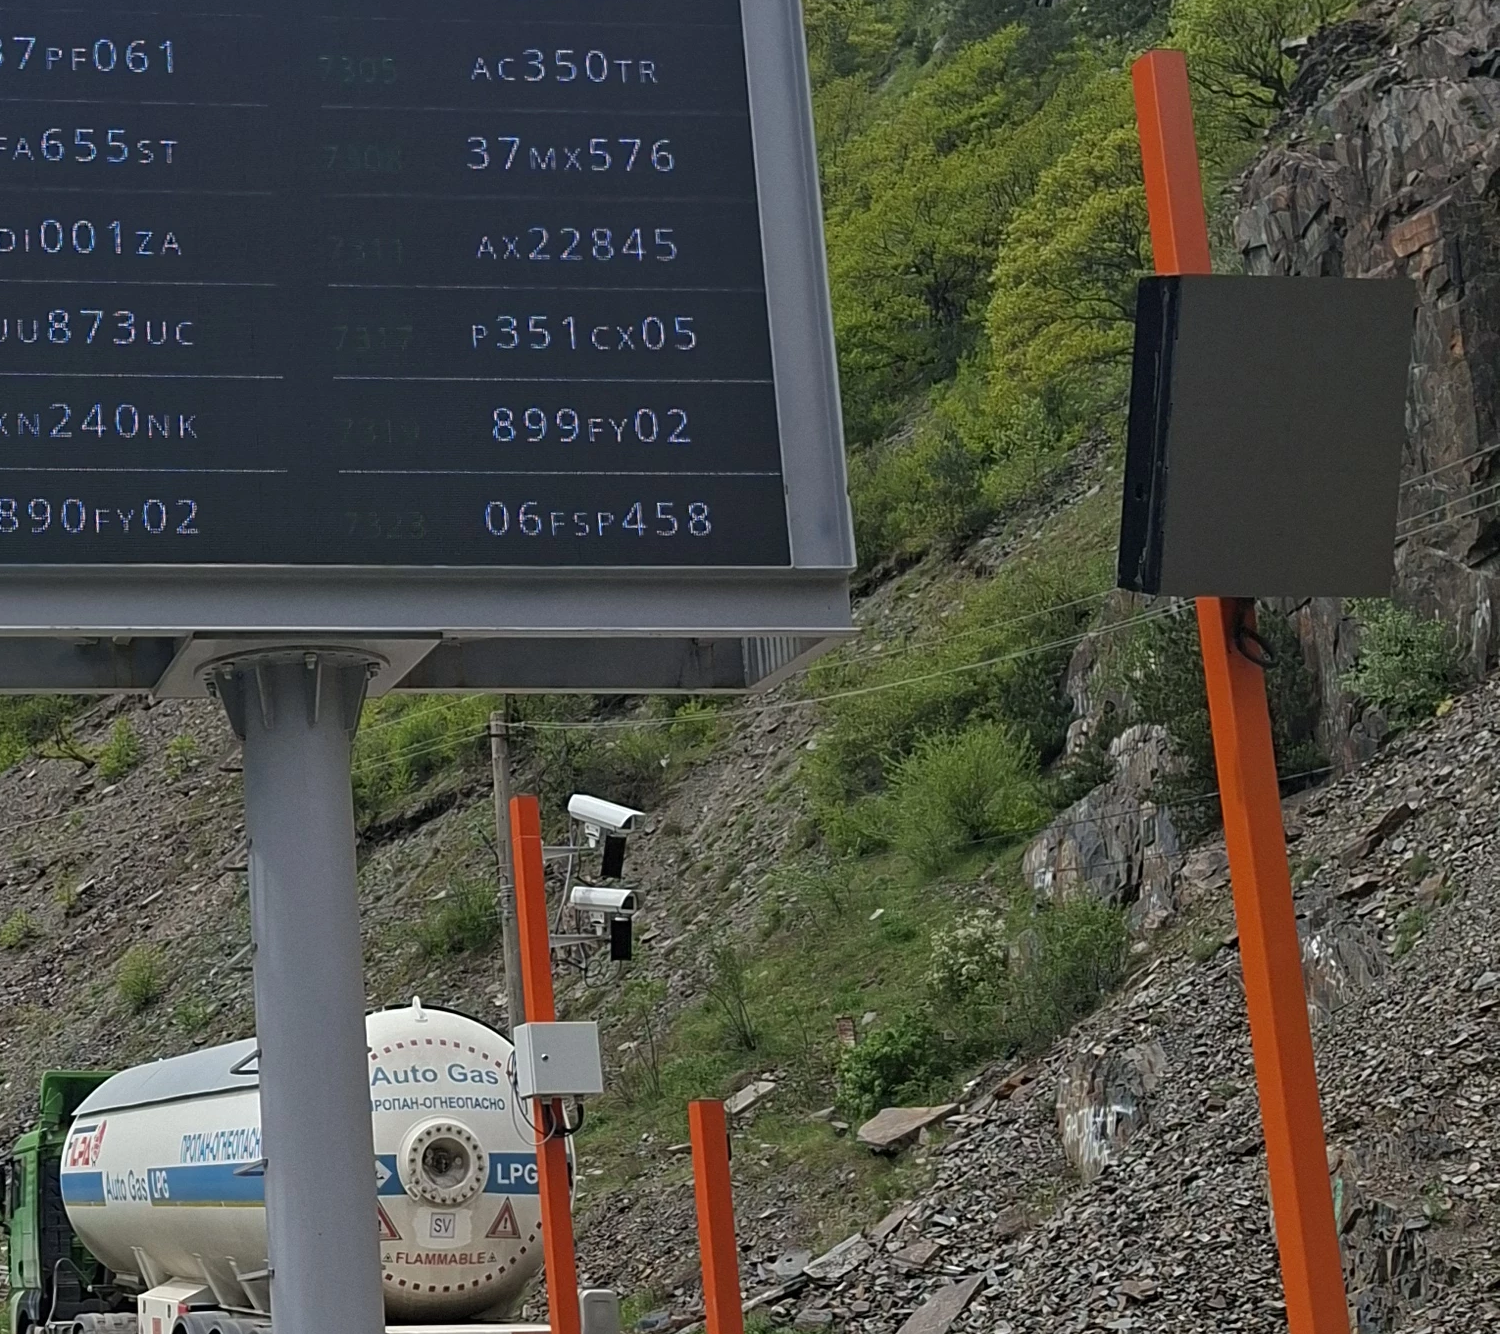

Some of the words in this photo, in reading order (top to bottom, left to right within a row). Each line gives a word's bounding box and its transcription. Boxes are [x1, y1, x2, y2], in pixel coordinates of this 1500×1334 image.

[471, 48, 658, 83] AC350TR
[466, 136, 675, 172] 37MX576
[477, 227, 678, 262] AX22845
[492, 407, 692, 443] 899FY02
[484, 500, 712, 537] 06FSP458
[371, 1064, 438, 1086] Auto
[447, 1063, 499, 1085] Gas
[372, 1096, 506, 1113] РОПАН-ОГНЕОПАСНО
[105, 1170, 126, 1201] Auto
[127, 1168, 148, 1201] Gas
[151, 1170, 170, 1199] LPG
[496, 1163, 539, 1185] LPG
[433, 1218, 452, 1234] SV
[395, 1251, 487, 1266] FLAMMABLE
